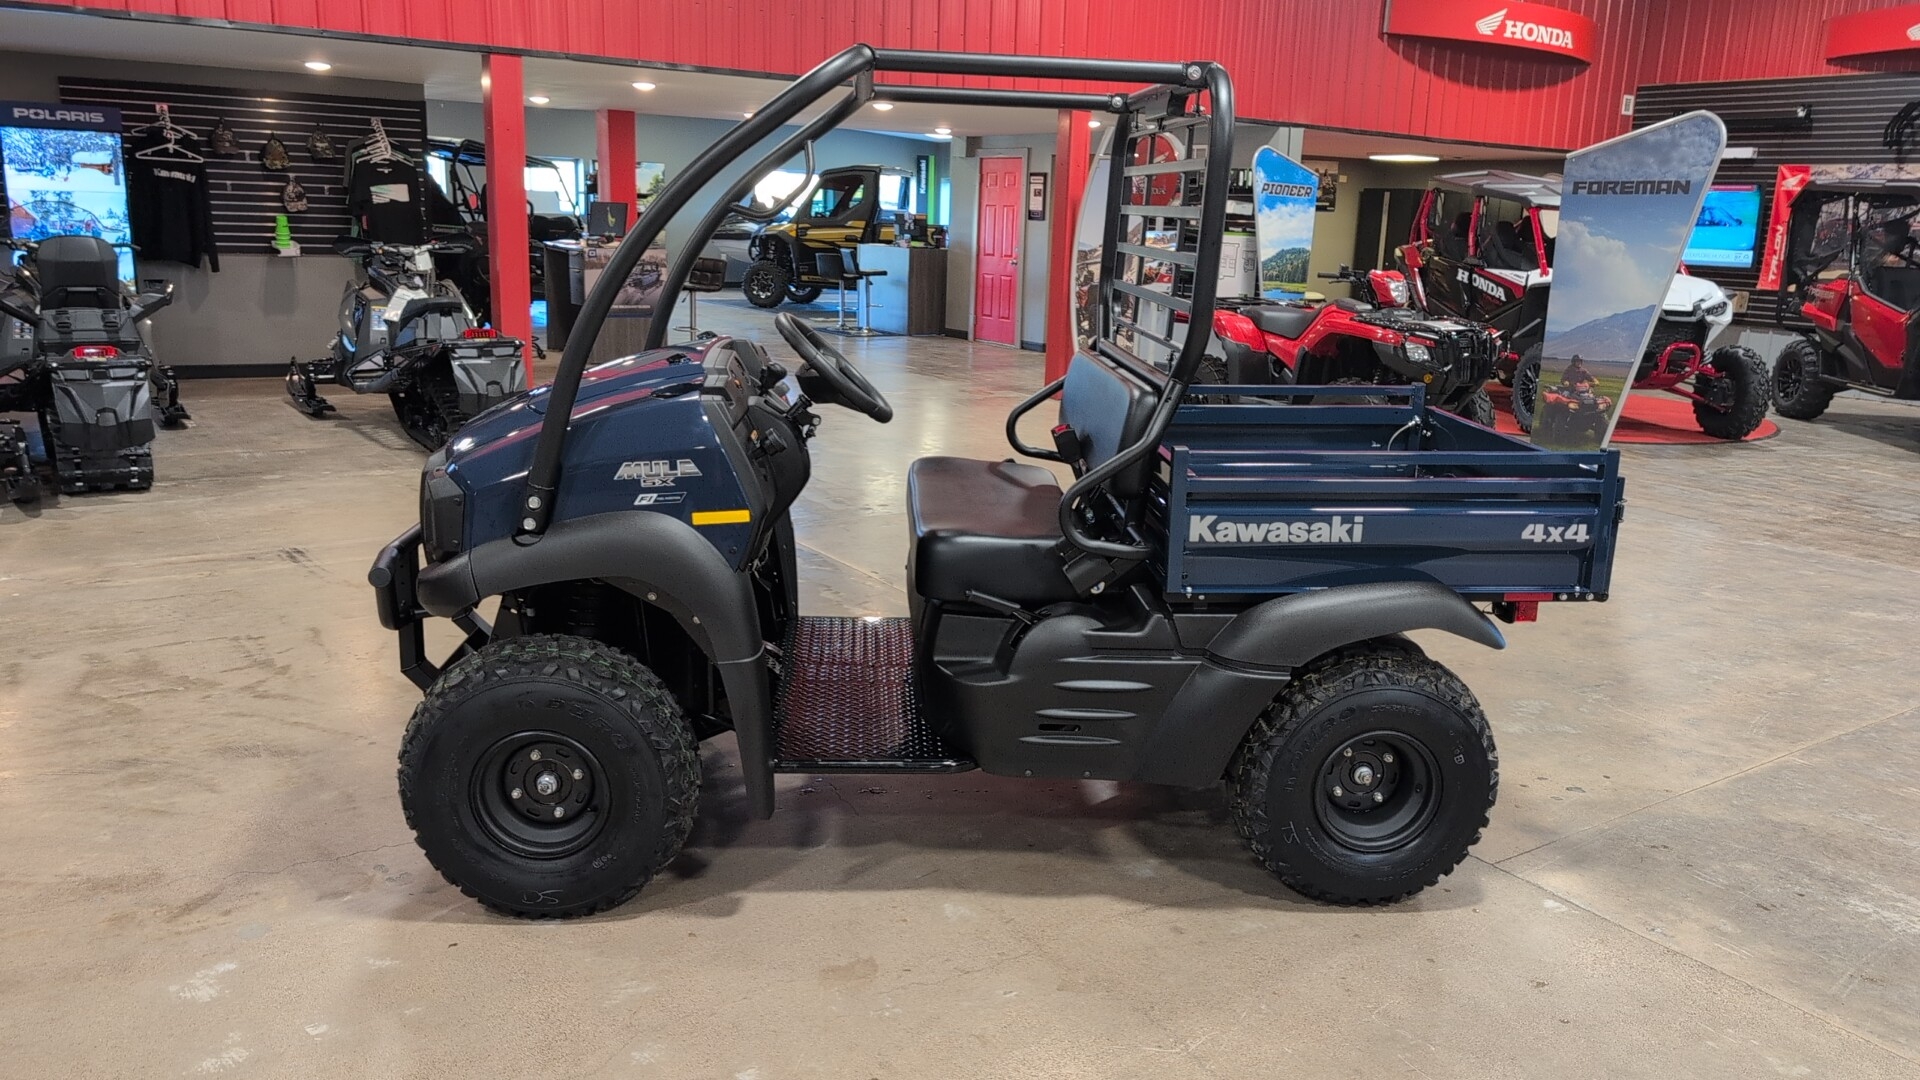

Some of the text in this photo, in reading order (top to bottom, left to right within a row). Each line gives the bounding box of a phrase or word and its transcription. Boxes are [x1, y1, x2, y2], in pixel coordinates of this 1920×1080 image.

[1503, 19, 1573, 49] HONDA
[12, 107, 105, 123] POLARIS
[919, 159, 927, 194] Kawasaki
[1261, 182, 1313, 198] PIONEER
[1571, 180, 1691, 195] FOREMAN
[1767, 224, 1784, 283] TALON
[1456, 268, 1507, 301] HONDA
[613, 459, 703, 480] MULE
[640, 477, 676, 487] SX
[1189, 515, 1364, 542] Kawasaki
[1521, 523, 1590, 543] 4x4
